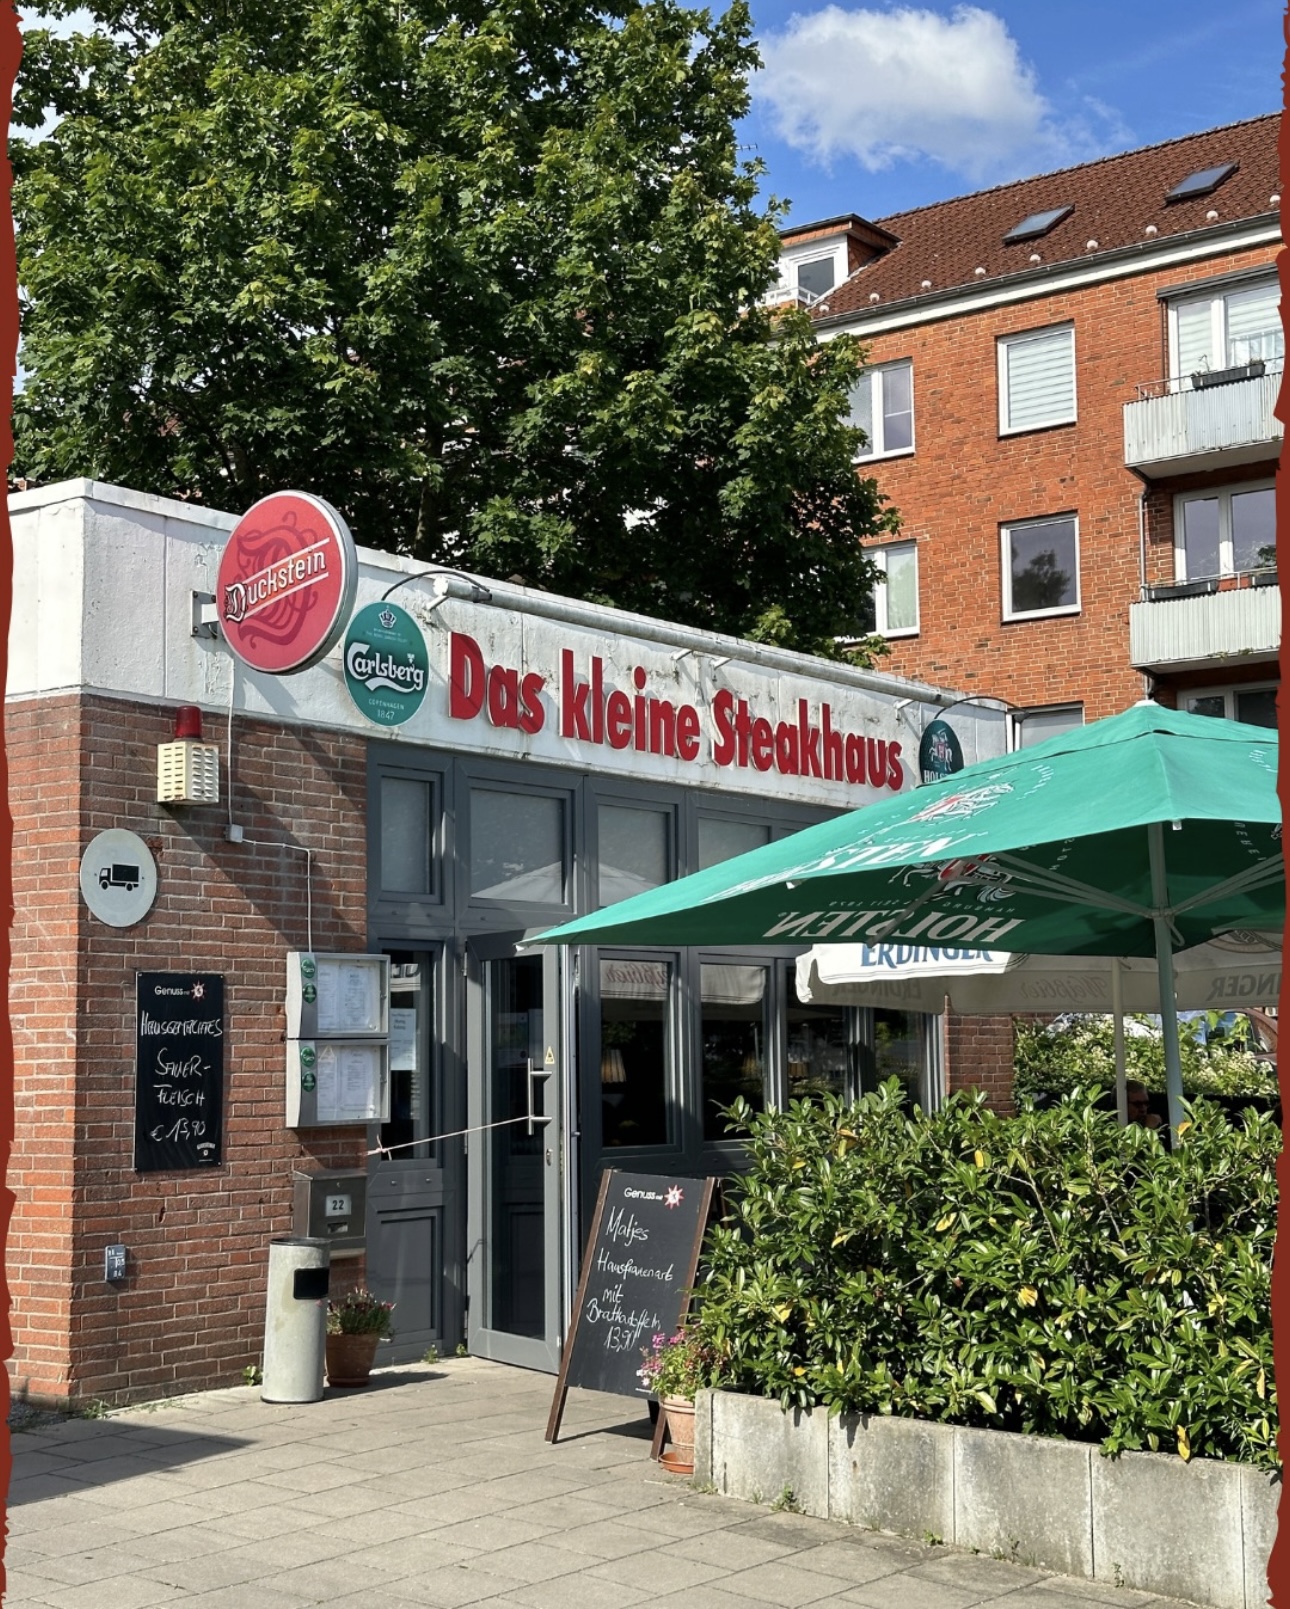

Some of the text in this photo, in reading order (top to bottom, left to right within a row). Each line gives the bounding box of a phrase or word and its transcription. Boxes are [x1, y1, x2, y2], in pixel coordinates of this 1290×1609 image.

[223, 547, 327, 623] Duckstein
[346, 641, 425, 692] Carlsberg
[368, 698, 405, 710] COPENHAGEN
[449, 631, 903, 791] Das kleine Steakhaus
[377, 708, 395, 720] 1847
[154, 985, 184, 996] Genuss
[150, 1124, 164, 1142] €
[624, 1186, 656, 1200] Genuss
[332, 1199, 345, 1210] 22
[605, 1206, 649, 1247] Matjes
[602, 1283, 624, 1303] mit
[603, 1326, 635, 1352] 13,90
